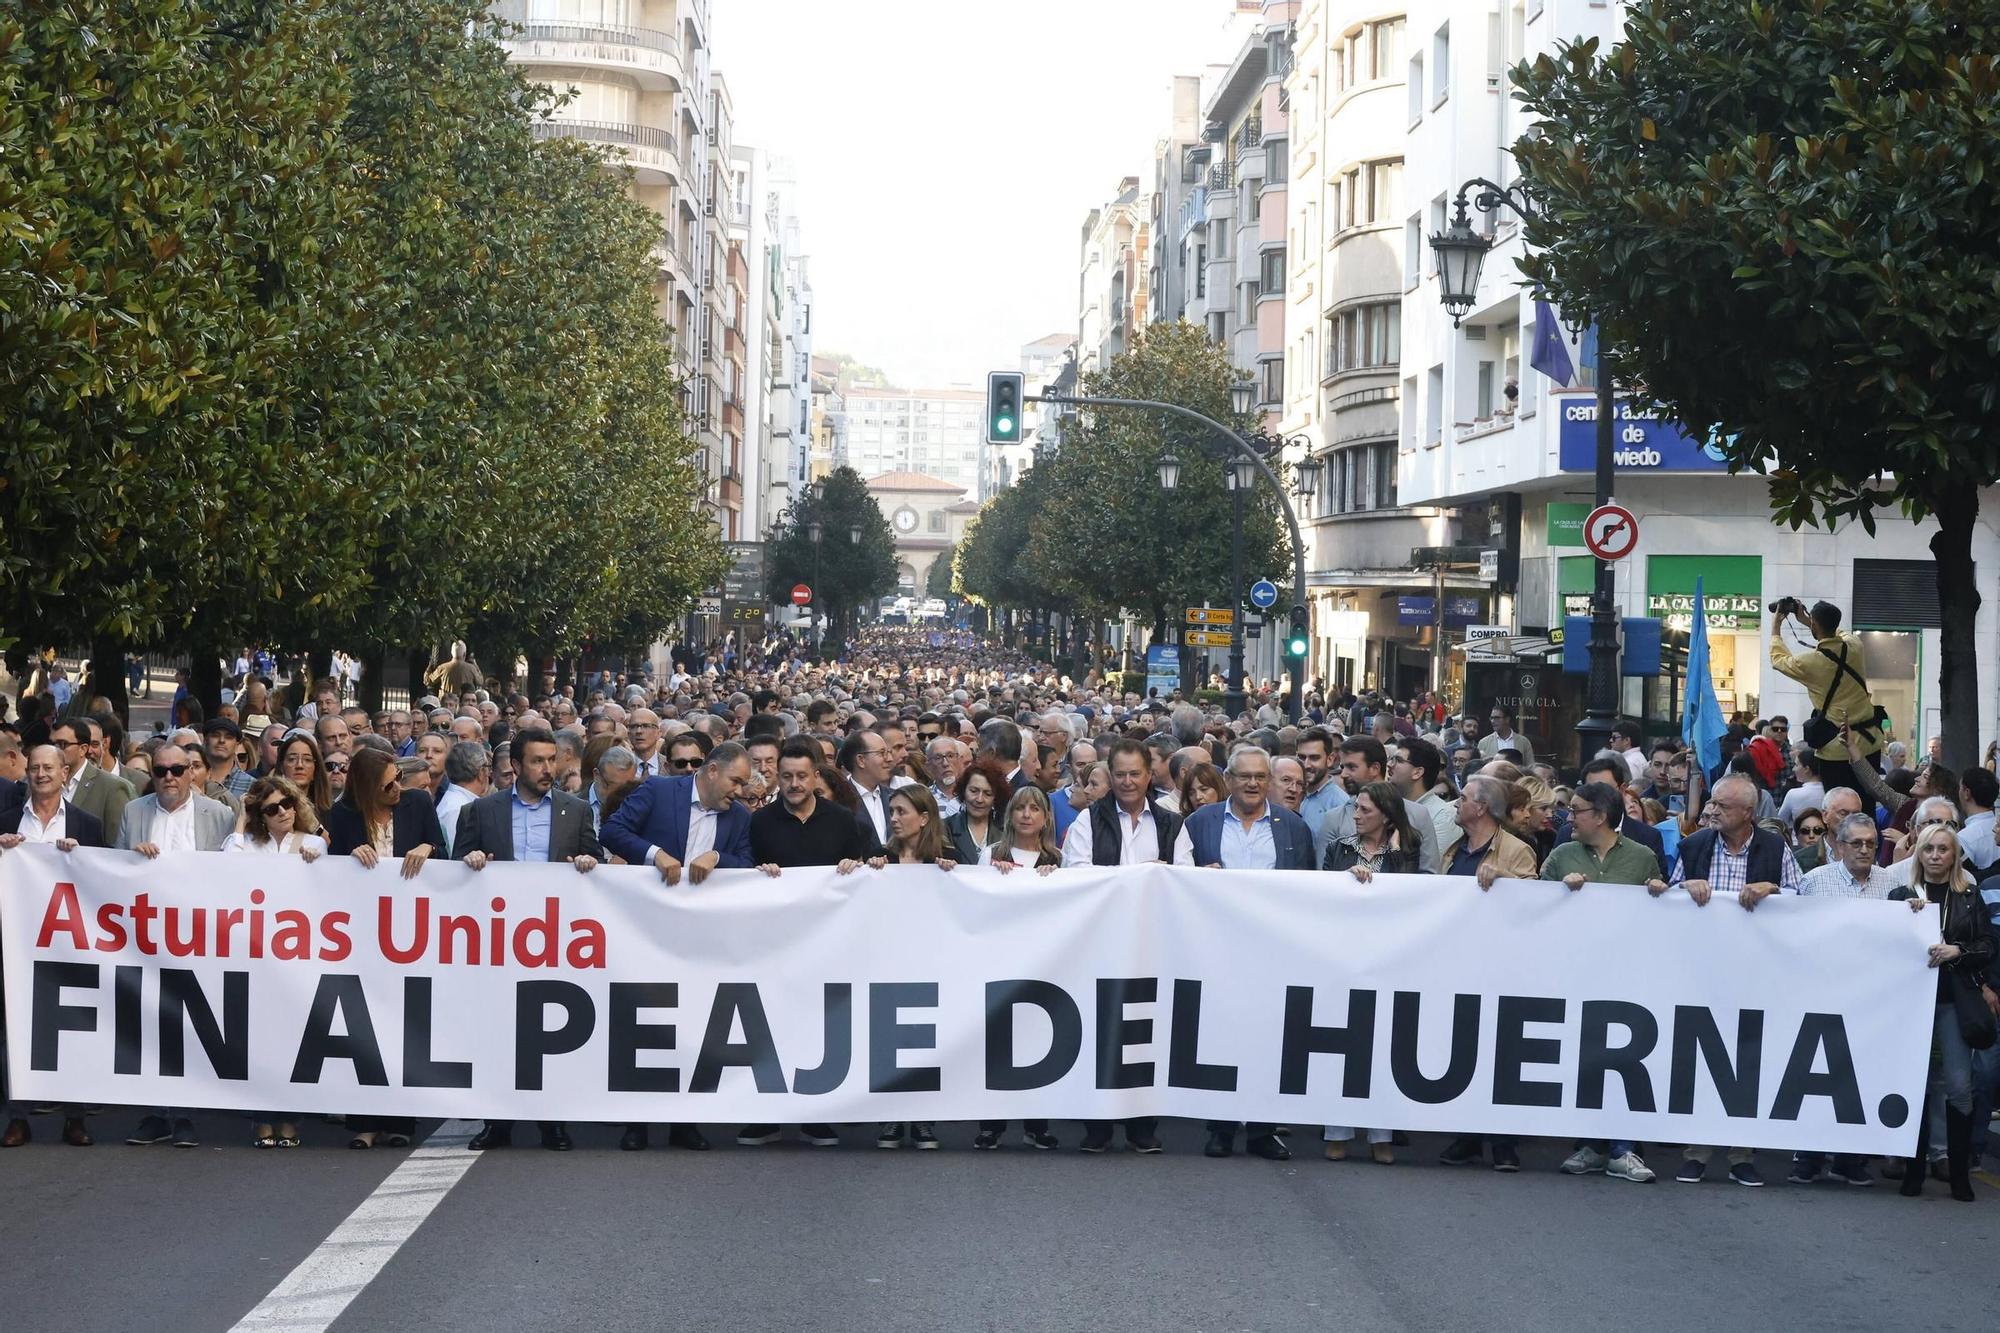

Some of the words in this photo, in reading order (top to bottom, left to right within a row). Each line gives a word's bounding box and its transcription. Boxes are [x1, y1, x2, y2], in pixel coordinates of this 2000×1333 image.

[1622, 423, 1645, 443] de
[1613, 446, 1661, 466] viedo
[1649, 596, 1668, 609] LA
[1709, 599, 1727, 611] DE
[1731, 599, 1758, 612] LAS
[1471, 630, 1508, 639] COMPRO
[1554, 633, 1562, 641] A2
[1495, 697, 1532, 707] NUEVO
[36, 883, 352, 962] Asturias
[378, 896, 607, 970] Unida
[30, 960, 250, 1081] FIN
[289, 973, 473, 1089] AL
[514, 979, 941, 1095] PEAJE
[984, 977, 1239, 1093] DEL
[1278, 985, 1909, 1129] HUERNA.
